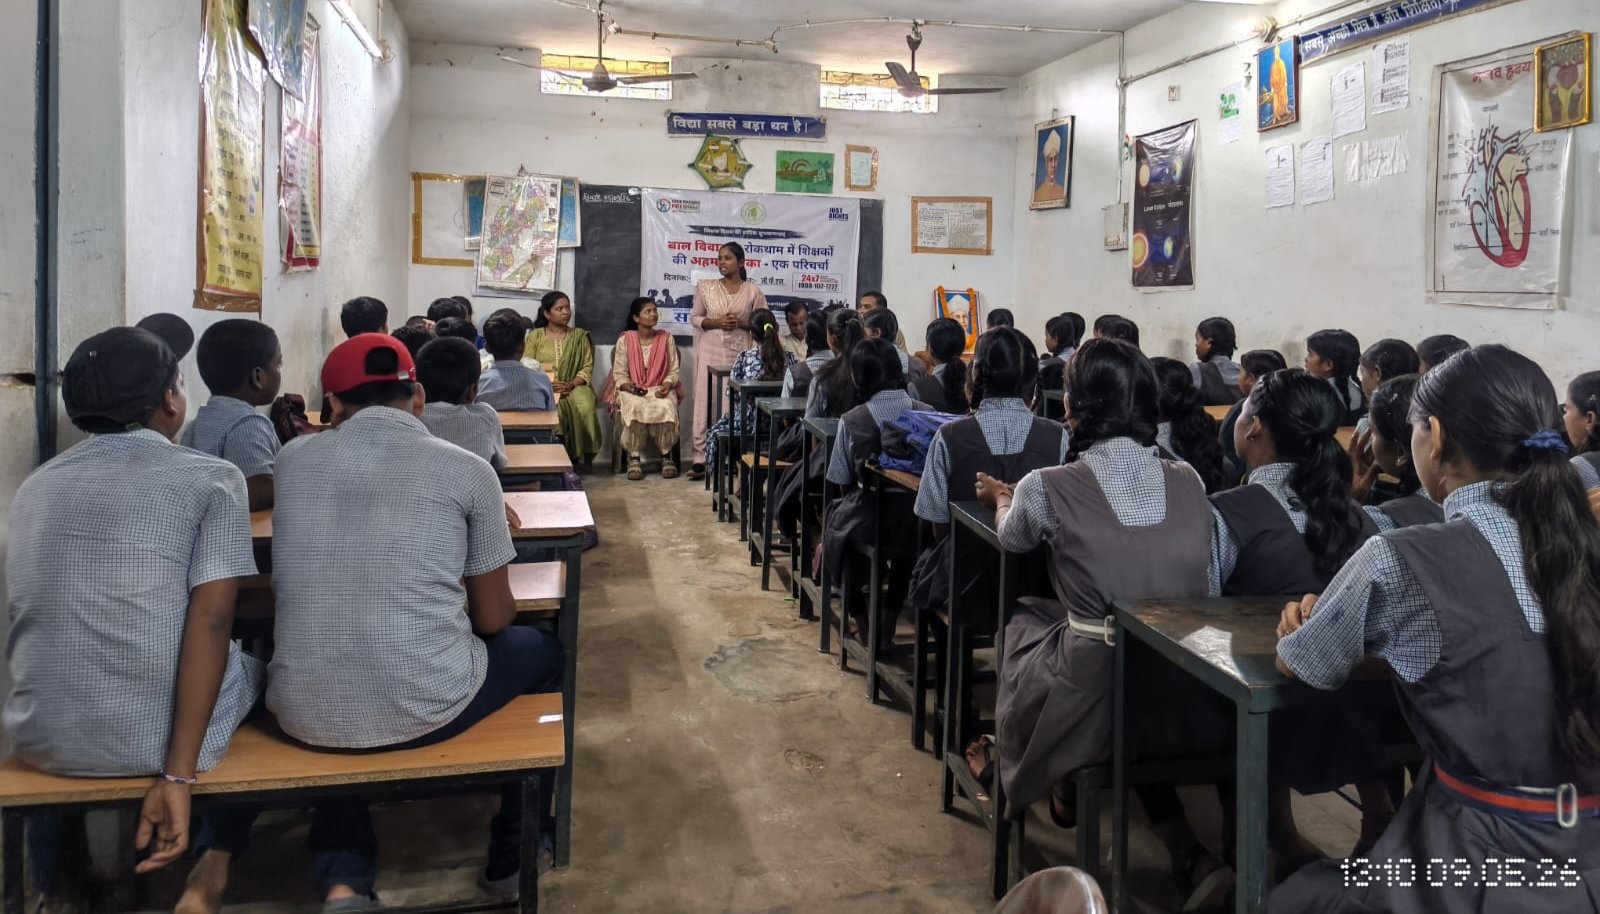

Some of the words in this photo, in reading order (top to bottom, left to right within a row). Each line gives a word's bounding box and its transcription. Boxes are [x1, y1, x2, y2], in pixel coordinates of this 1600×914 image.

[1328, 23, 1351, 43] अच्छी
[1351, 18, 1370, 35] मित्र
[1369, 13, 1380, 29] है
[1383, 5, 1402, 24] और
[672, 116, 700, 129] विद्या
[706, 116, 737, 130] सबसे
[742, 119, 765, 132] बड़ा
[770, 121, 788, 132] धन
[668, 241, 691, 251] बाल
[695, 240, 723, 252] विवा
[744, 242, 783, 254] रोकथाम
[787, 241, 795, 255] में
[798, 244, 834, 256] शिक्षकों
[672, 253, 687, 265] की
[772, 260, 789, 271] एक
[793, 258, 828, 271] परिचर्चा
[801, 274, 820, 283] 24x7
